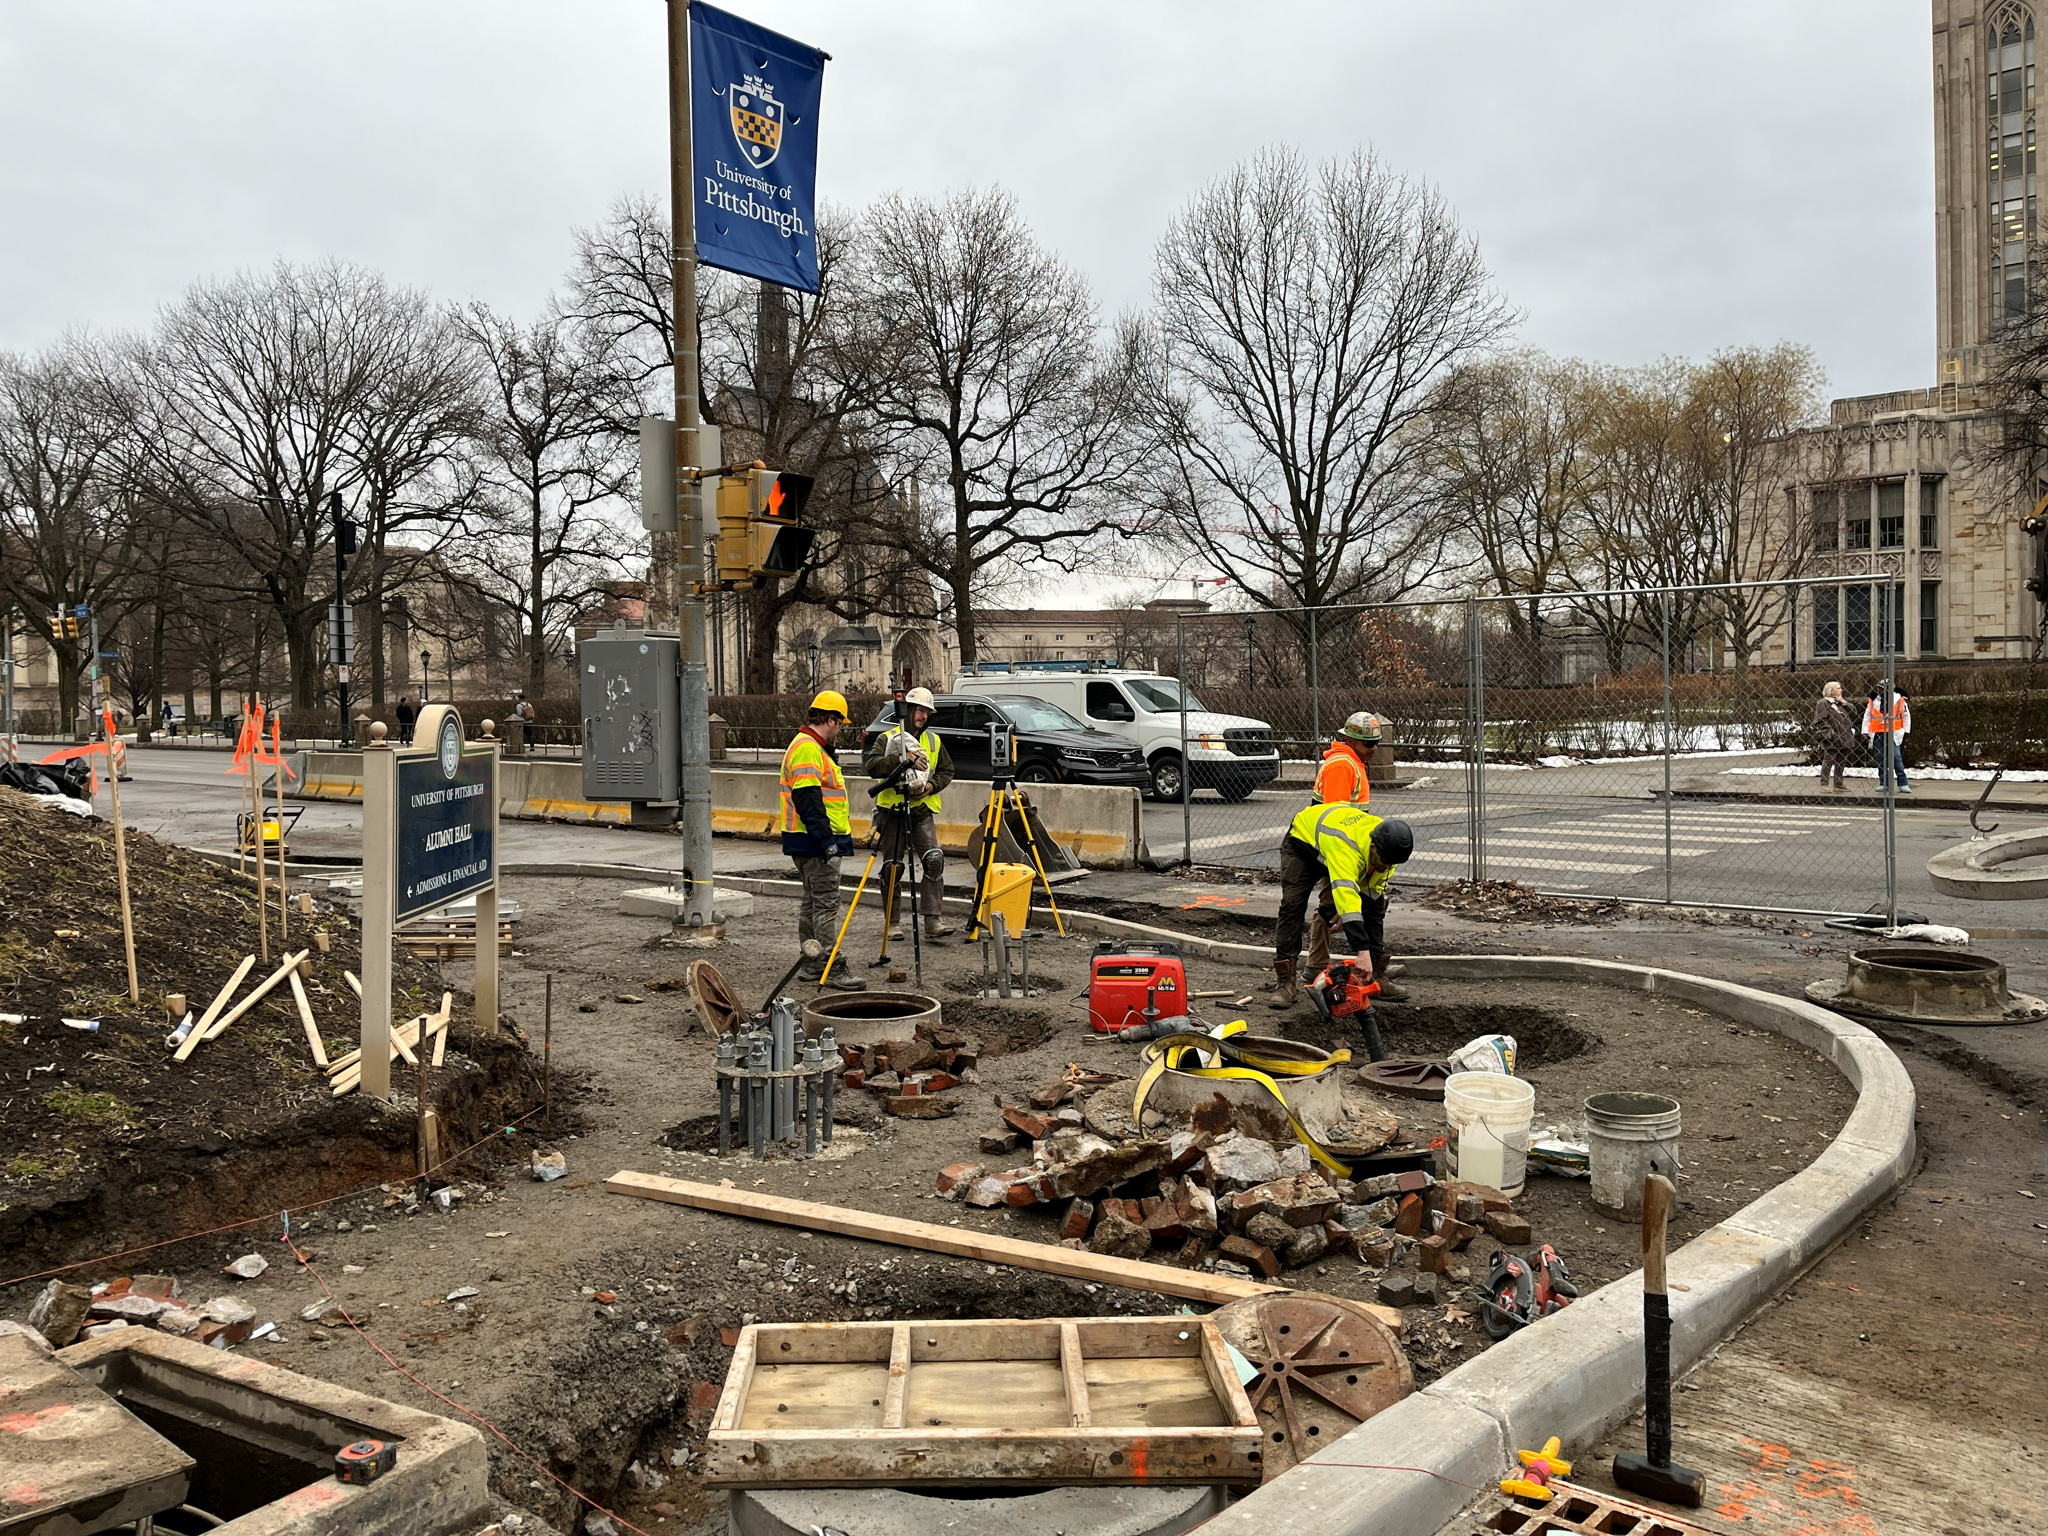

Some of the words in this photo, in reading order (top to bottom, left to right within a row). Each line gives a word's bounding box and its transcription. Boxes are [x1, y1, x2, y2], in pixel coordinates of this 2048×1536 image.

[715, 160, 778, 199] University
[779, 185, 792, 200] of
[704, 176, 805, 238] Pittsburgh
[411, 789, 446, 808] UNIVERSITY
[446, 789, 454, 800] OF
[454, 783, 484, 800] PITTSBURGH
[425, 828, 454, 851] ALUMNI
[454, 823, 472, 844] HALL
[416, 873, 446, 895] ADMISSIONS
[447, 872, 452, 883] &
[452, 861, 478, 882] FINANCIAL
[478, 860, 487, 872] AID
